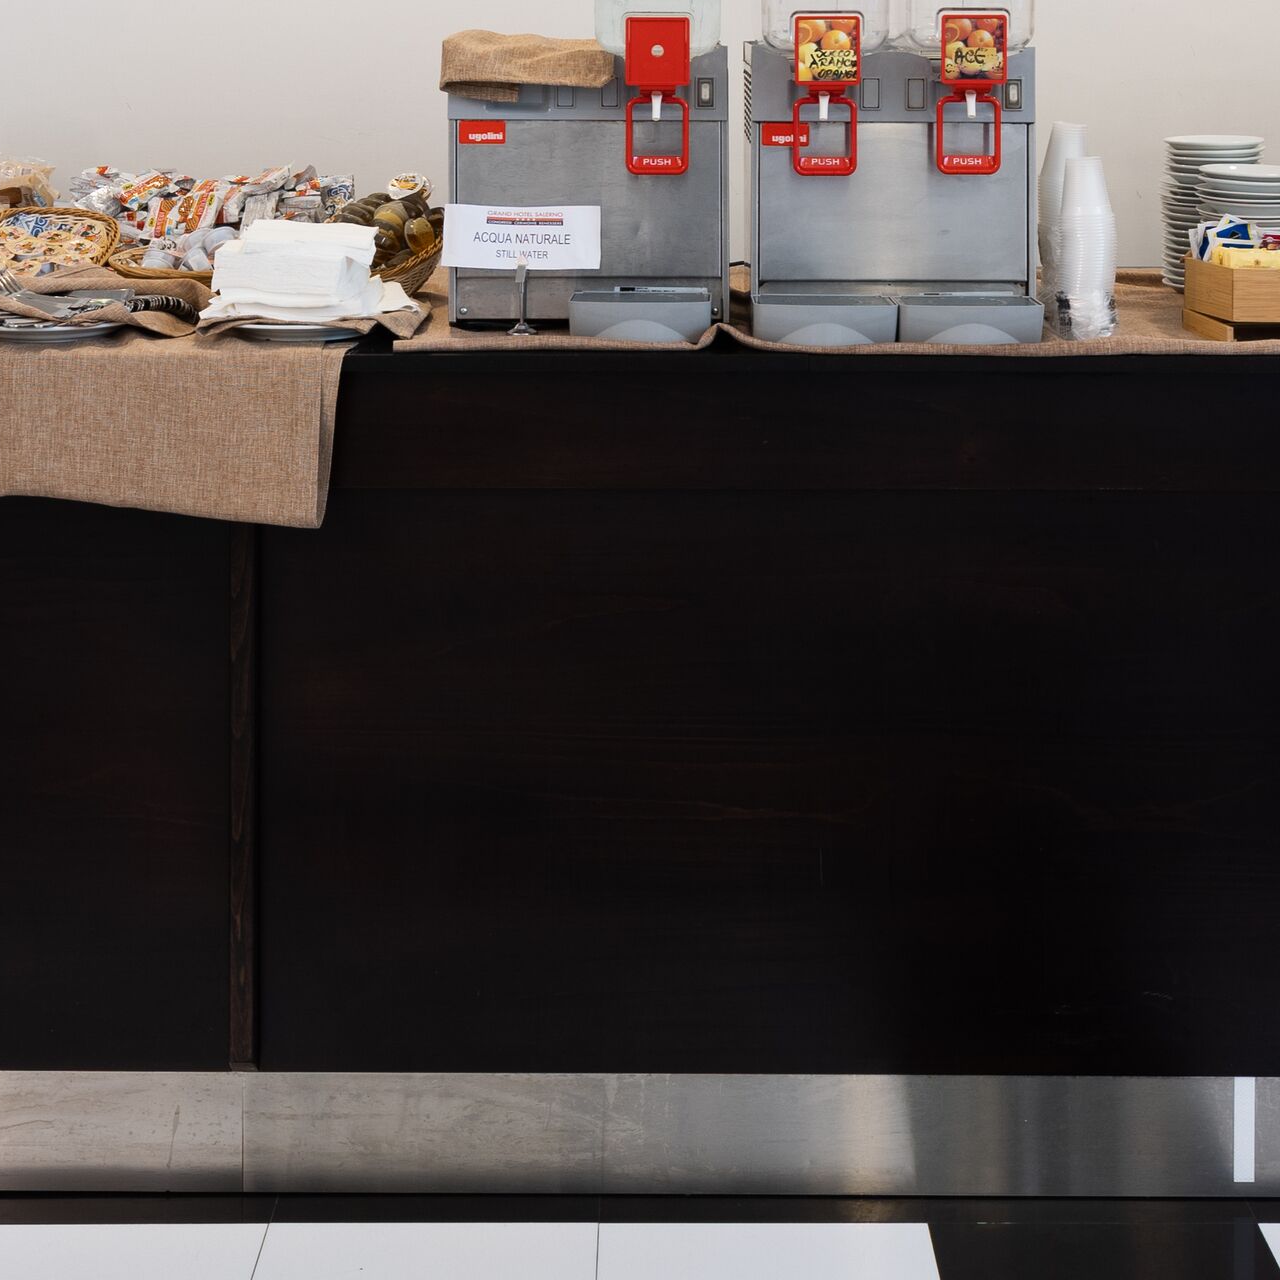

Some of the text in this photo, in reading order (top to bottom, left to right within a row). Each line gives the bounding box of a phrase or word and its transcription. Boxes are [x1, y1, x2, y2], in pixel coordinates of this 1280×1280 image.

[954, 47, 986, 65] ACE
[468, 131, 503, 142] ugolini
[642, 157, 671, 166] PUSH
[811, 157, 840, 166] PUSH
[952, 157, 982, 166] PUSH
[473, 231, 571, 245] ACQUA NATURALE
[495, 249, 548, 259] STILL WATER
